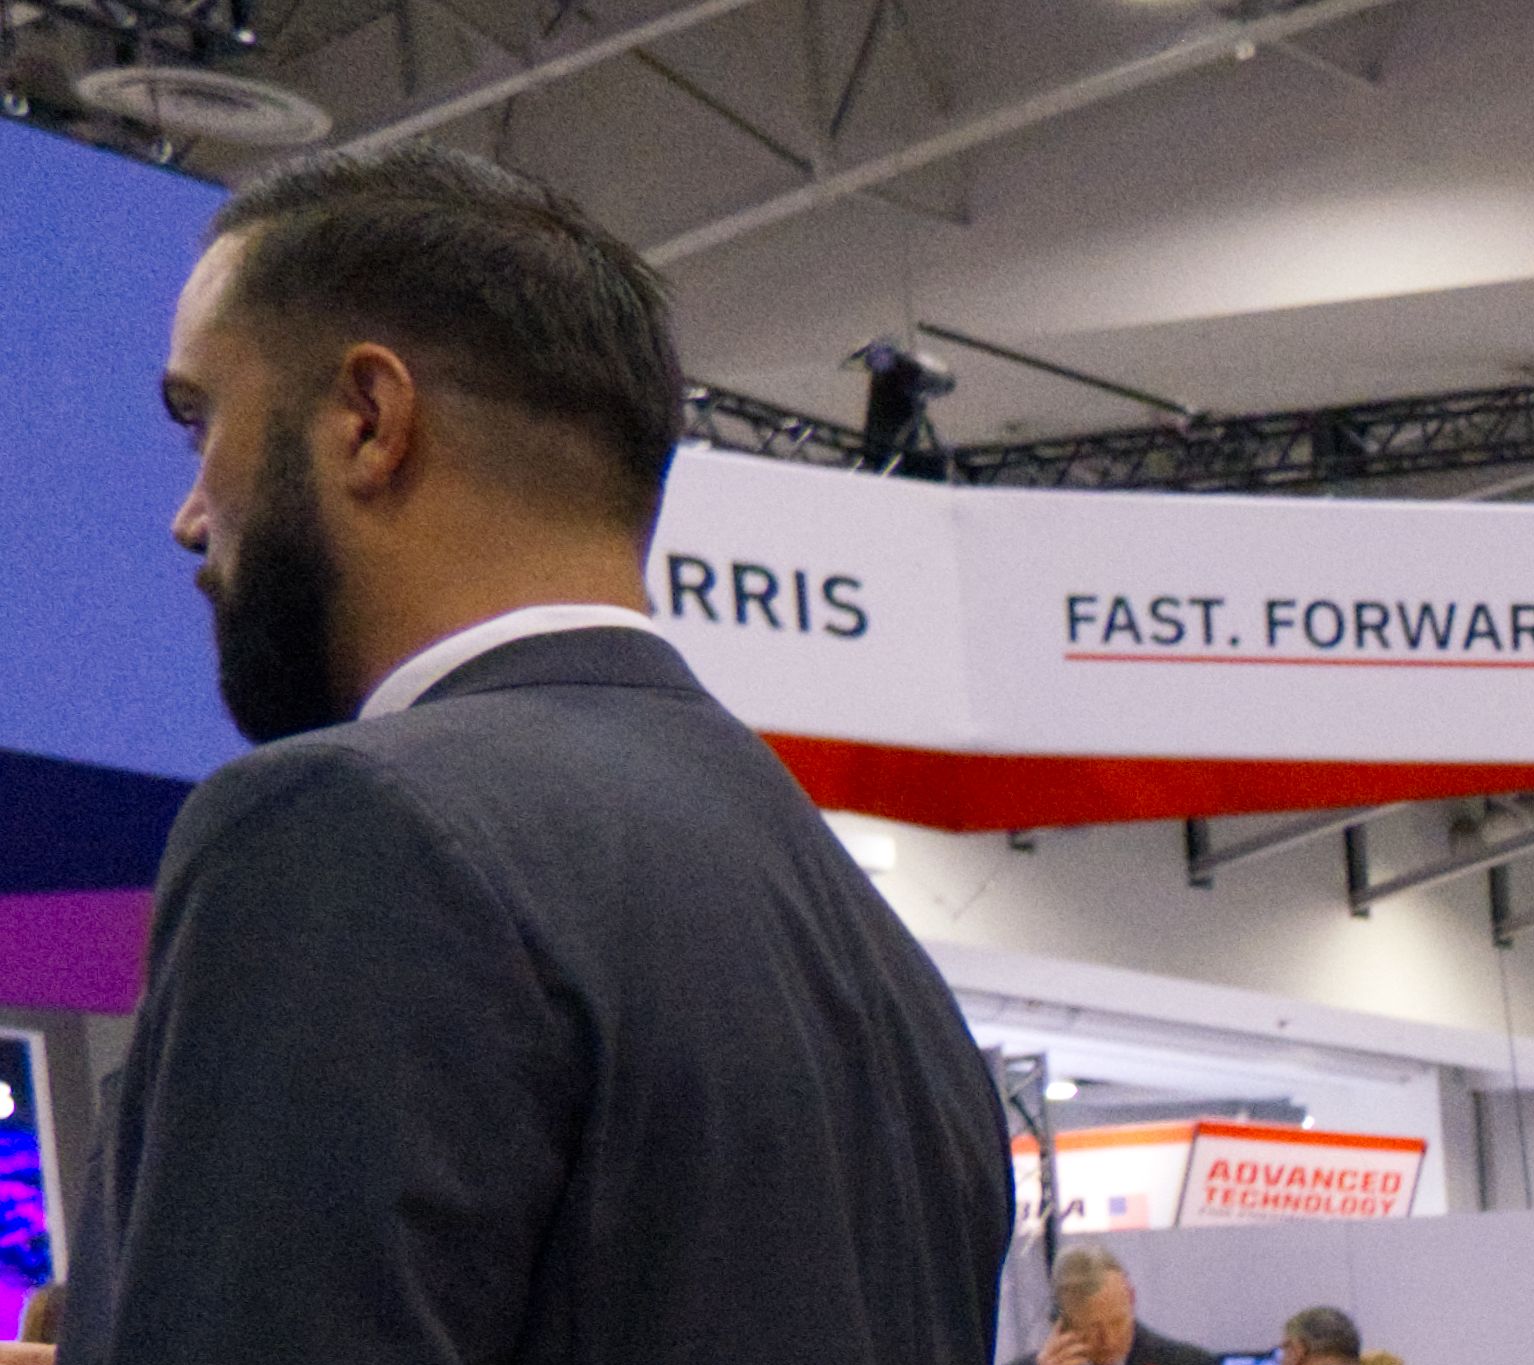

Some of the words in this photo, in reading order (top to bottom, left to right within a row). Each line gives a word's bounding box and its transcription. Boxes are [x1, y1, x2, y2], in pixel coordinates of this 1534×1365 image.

[651, 553, 870, 639] RRIS
[1066, 595, 1241, 647] FAST.
[1207, 1158, 1402, 1195] ADVANCED
[1204, 1185, 1397, 1216] TECHNOLOGY
